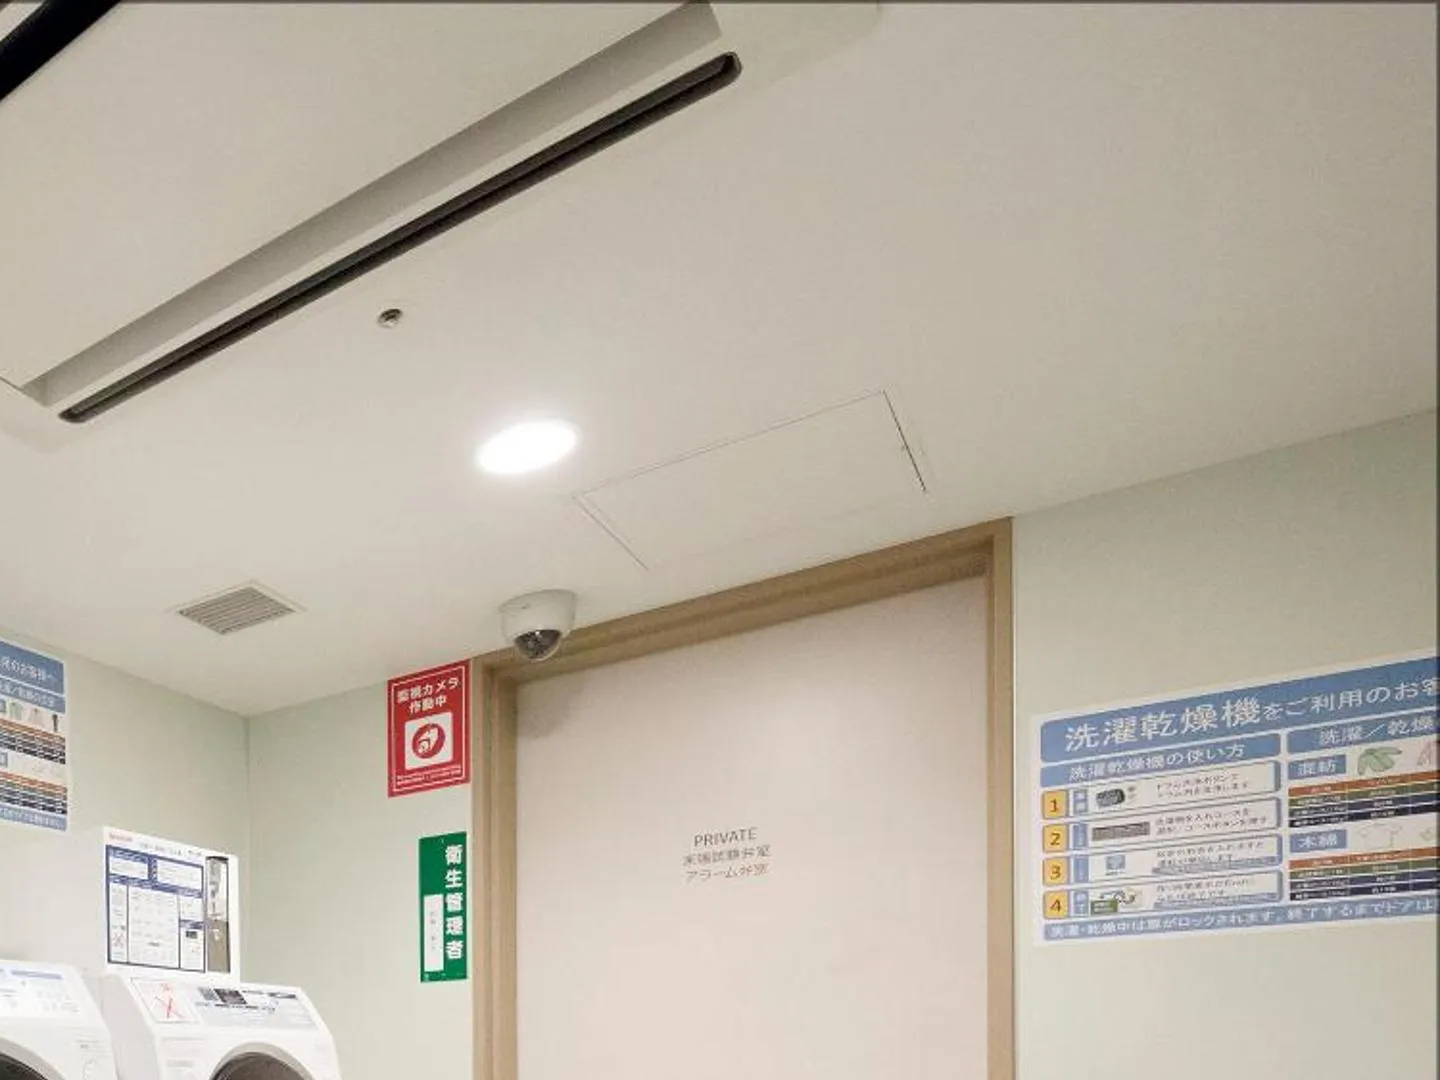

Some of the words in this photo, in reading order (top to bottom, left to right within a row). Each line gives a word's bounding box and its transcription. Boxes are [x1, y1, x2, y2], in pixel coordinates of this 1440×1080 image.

[1068, 743, 1246, 780] 洗濯乾燥機の使い方
[1049, 798, 1060, 812] 1
[694, 826, 758, 847] PRIVATE
[1050, 832, 1061, 847] 2
[1050, 865, 1061, 880] 3
[445, 844, 464, 960] 衛生管理者
[1050, 898, 1062, 913] 4
